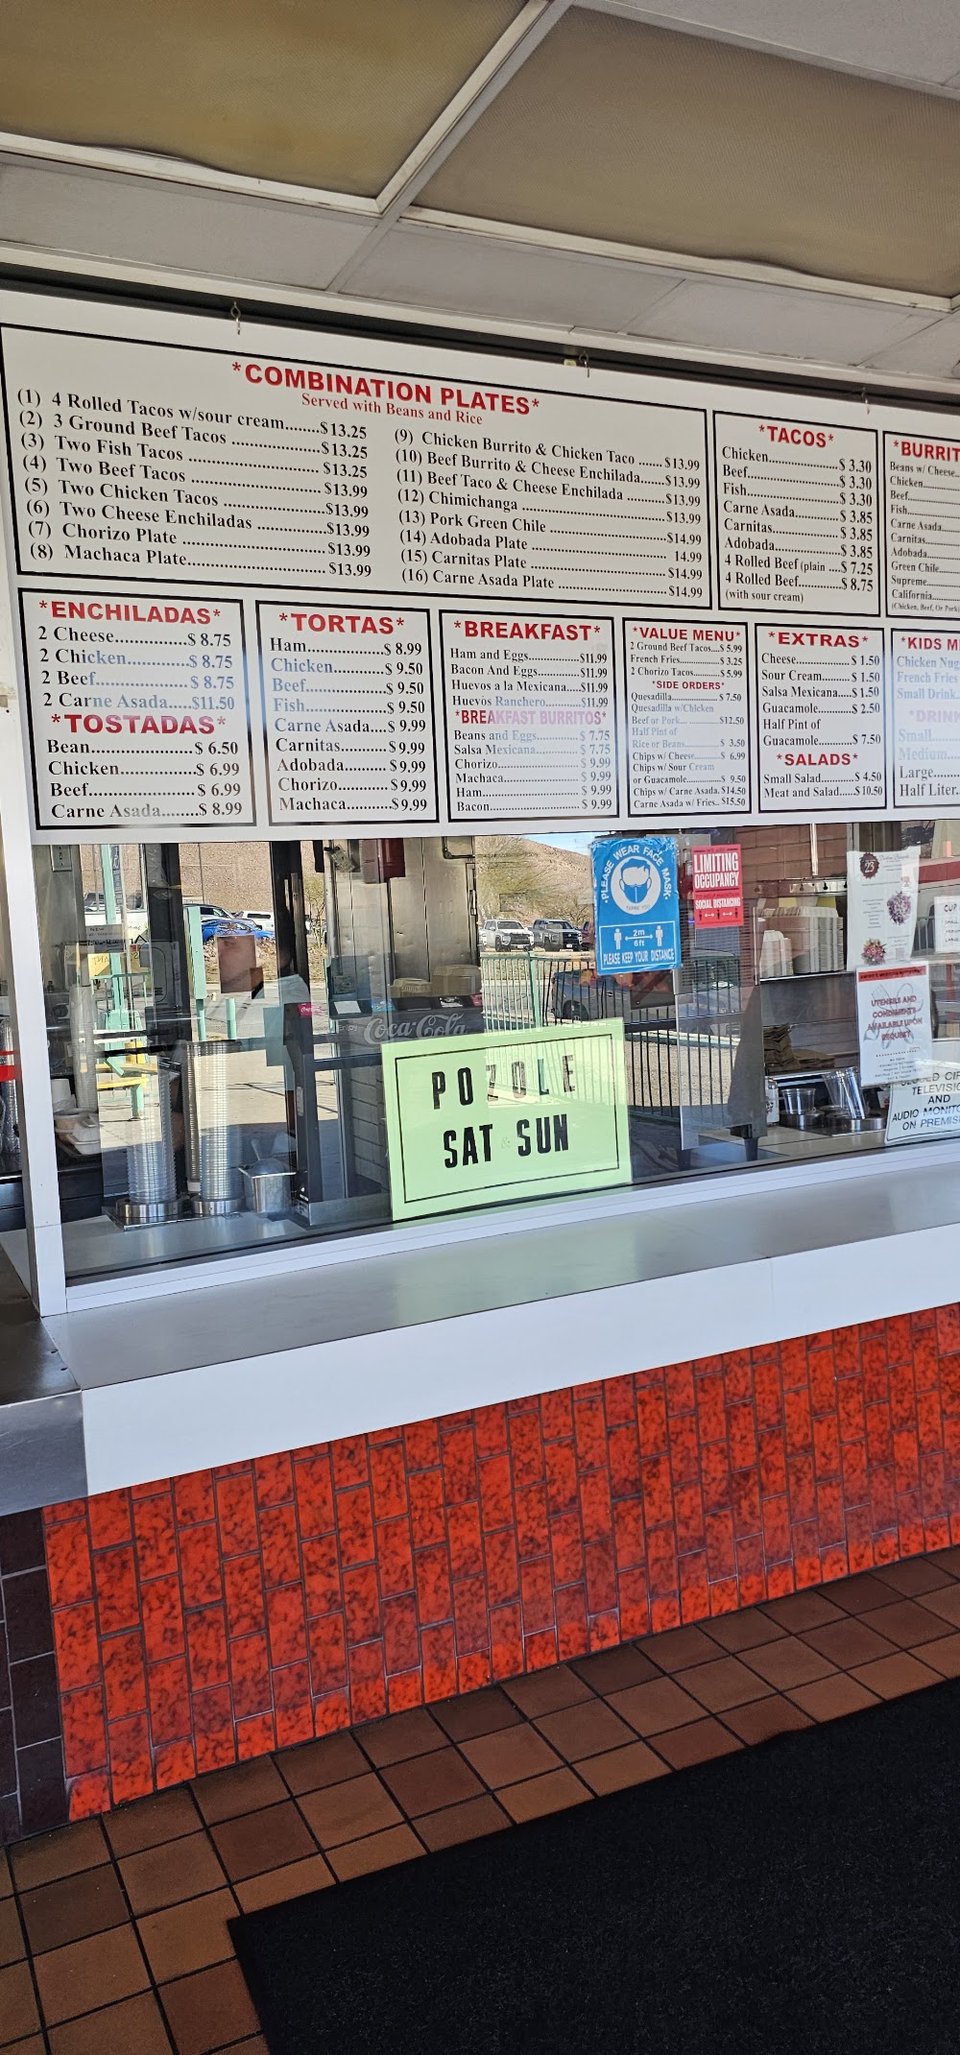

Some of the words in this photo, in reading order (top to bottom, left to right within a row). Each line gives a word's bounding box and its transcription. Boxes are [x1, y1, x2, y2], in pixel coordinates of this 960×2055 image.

[18, 389, 41, 407] (1)
[52, 392, 61, 406] 4
[68, 394, 122, 413] Rolled
[127, 400, 173, 418] Tacos
[179, 407, 232, 424] w/sour
[238, 416, 284, 430] cream
[302, 393, 348, 410] Served
[353, 400, 381, 414] with
[386, 403, 424, 418] Beans
[428, 410, 451, 421] and
[456, 410, 482, 425] Rice
[20, 411, 43, 429] (2)
[54, 414, 63, 428] 3
[69, 415, 135, 435] Ground
[142, 422, 178, 439] Beef
[181, 426, 226, 444] Tacos
[21, 433, 44, 451] (3)
[54, 435, 91, 452] Two
[97, 440, 132, 456] Fish
[137, 443, 183, 461] Tacos
[395, 429, 413, 446] (9)
[422, 432, 478, 449] Chicken
[483, 438, 531, 454] Burrito
[536, 443, 547, 456] &
[552, 445, 603, 461] Chicken
[606, 450, 635, 464] Taco
[665, 457, 700, 471] $13.99
[722, 446, 768, 462] Chicken
[396, 449, 422, 466] (10)
[428, 452, 458, 466] Beef
[461, 455, 511, 472] Burrito
[515, 460, 526, 473] &
[532, 461, 575, 478] Cheese
[580, 466, 640, 483] Enchilada
[723, 464, 749, 479] Beef
[890, 461, 914, 472] Beans
[397, 469, 423, 486] (11)
[428, 471, 458, 486] Beef
[460, 474, 492, 489] Taco
[496, 478, 508, 491] &
[513, 479, 557, 495] Cheese
[562, 484, 623, 500] Enchilada
[398, 489, 424, 506] (12)
[429, 491, 518, 513] Chimichanga
[724, 500, 758, 515] Carne
[761, 504, 795, 518] Asada
[29, 521, 51, 539] (7)
[63, 523, 130, 541] Chorizo
[136, 528, 177, 544] Plate
[890, 518, 915, 530] Carne
[918, 522, 942, 532] Asada
[31, 543, 53, 560] (8)
[65, 545, 140, 563] Machaca
[146, 550, 187, 566] Plate
[725, 554, 731, 566] 4
[736, 554, 771, 568] Rolled
[775, 557, 799, 570] Beef
[800, 561, 825, 574] (plain
[891, 561, 916, 572] Green
[402, 568, 428, 585] (16)
[433, 570, 475, 585] Carne
[478, 574, 518, 587] Asada
[523, 575, 554, 589] Plate
[726, 589, 749, 600] (with
[774, 593, 804, 603] cream)
[38, 626, 47, 640] 2
[54, 627, 114, 643] Cheese
[630, 642, 634, 650] 2
[637, 642, 668, 651] Ground
[670, 643, 688, 652] Beef
[688, 643, 712, 652] Tacos
[451, 648, 476, 659] Ham
[480, 650, 500, 660] and
[504, 650, 530, 663] Eggs
[630, 654, 658, 664] French
[896, 654, 937, 668] Chicken
[451, 664, 484, 675] Bacon
[487, 665, 509, 676] And
[514, 666, 539, 679] Eggs
[762, 670, 786, 680] Sour
[789, 670, 822, 681] Cream
[452, 680, 491, 690] Huevos
[495, 683, 500, 691] a
[504, 680, 513, 691] la
[517, 681, 566, 692] Mexicana
[43, 692, 52, 706] 2
[59, 693, 111, 707] Carne
[117, 694, 168, 709] Asada
[275, 718, 321, 732] Carne
[326, 720, 372, 733] Asada
[764, 719, 786, 730] Half
[788, 719, 808, 730] Pint
[811, 719, 821, 730] of
[765, 788, 789, 798] Meat
[792, 787, 810, 797] and
[813, 786, 841, 797] Salad
[613, 844, 640, 861] WEAR
[642, 846, 664, 866] FACE
[694, 852, 738, 873] LIMITING
[695, 872, 739, 889] OCCUPANCY
[604, 952, 621, 965] PLEASE
[622, 951, 634, 963] KEEP
[635, 950, 648, 962] YOUR
[902, 995, 917, 1004] AND
[431, 1055, 576, 1110] POZOLE
[928, 1094, 951, 1104] AND
[892, 1108, 919, 1122] AUDIO
[902, 1120, 917, 1131] ON
[443, 1124, 493, 1169] SAT
[516, 1114, 569, 1157] SUN
